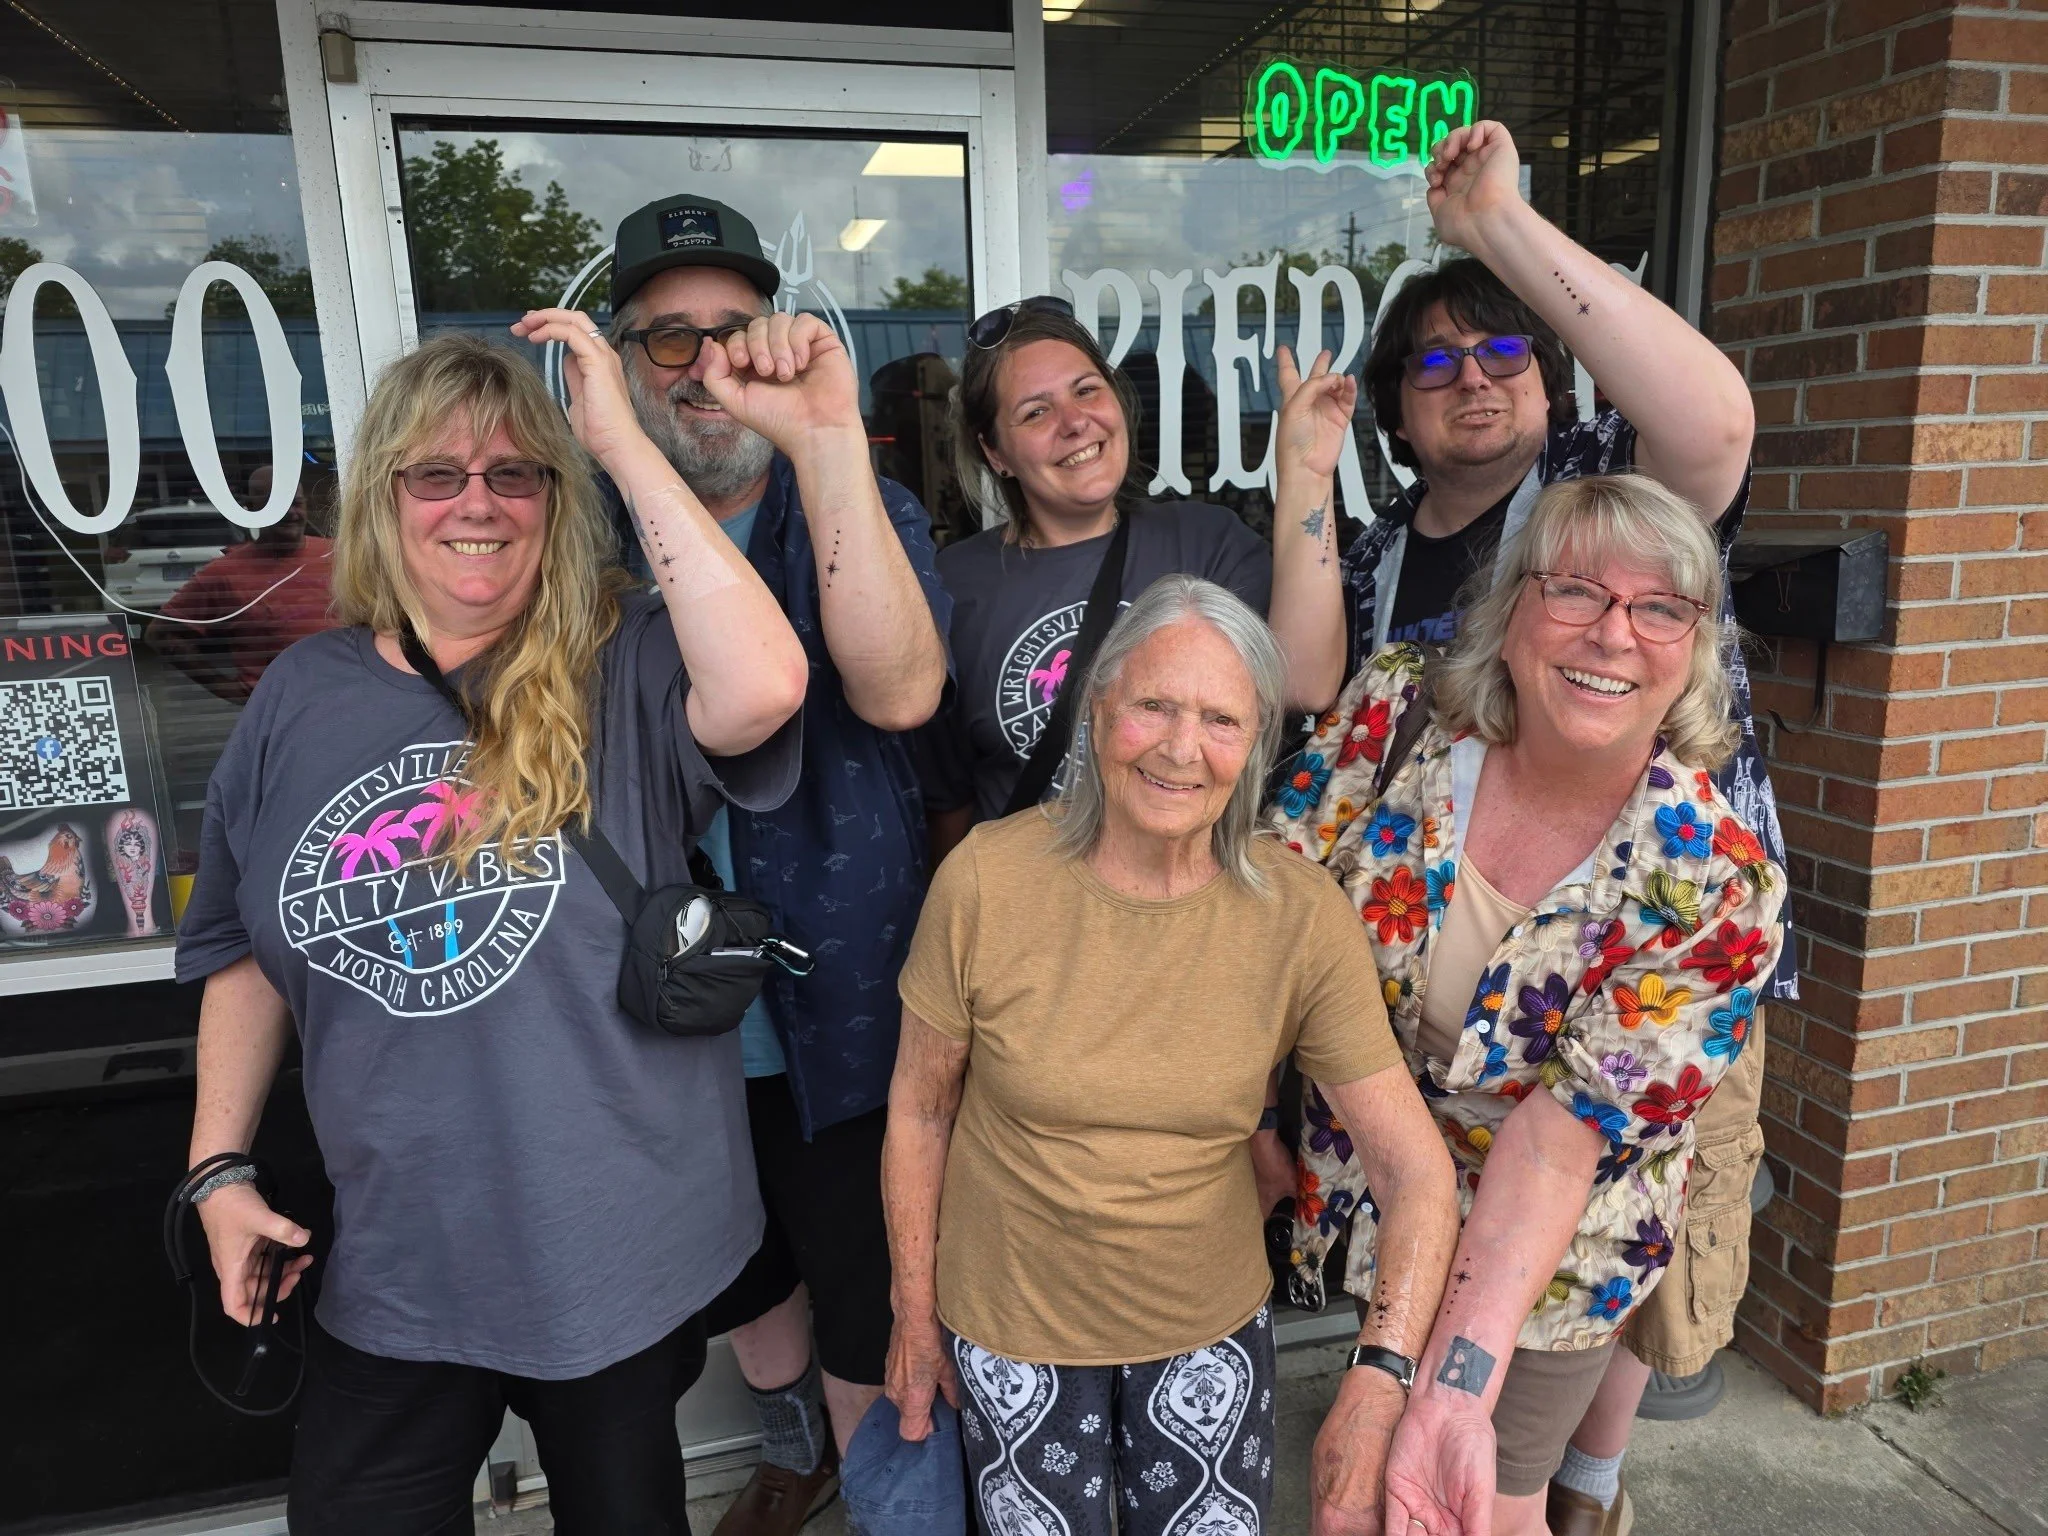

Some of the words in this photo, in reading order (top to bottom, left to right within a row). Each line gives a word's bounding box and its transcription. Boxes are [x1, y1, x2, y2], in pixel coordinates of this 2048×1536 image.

[1256, 62, 1473, 169] OPEN
[668, 209, 707, 219] ELEMENT
[1061, 243, 1648, 527] PIERC
[4, 633, 128, 662] NING
[1003, 608, 1085, 707] WRIGHTSVI
[289, 870, 409, 937] SALTY
[428, 918, 464, 940] 1899
[330, 949, 408, 1007] NORTH
[420, 906, 540, 1007] CAROLINA
